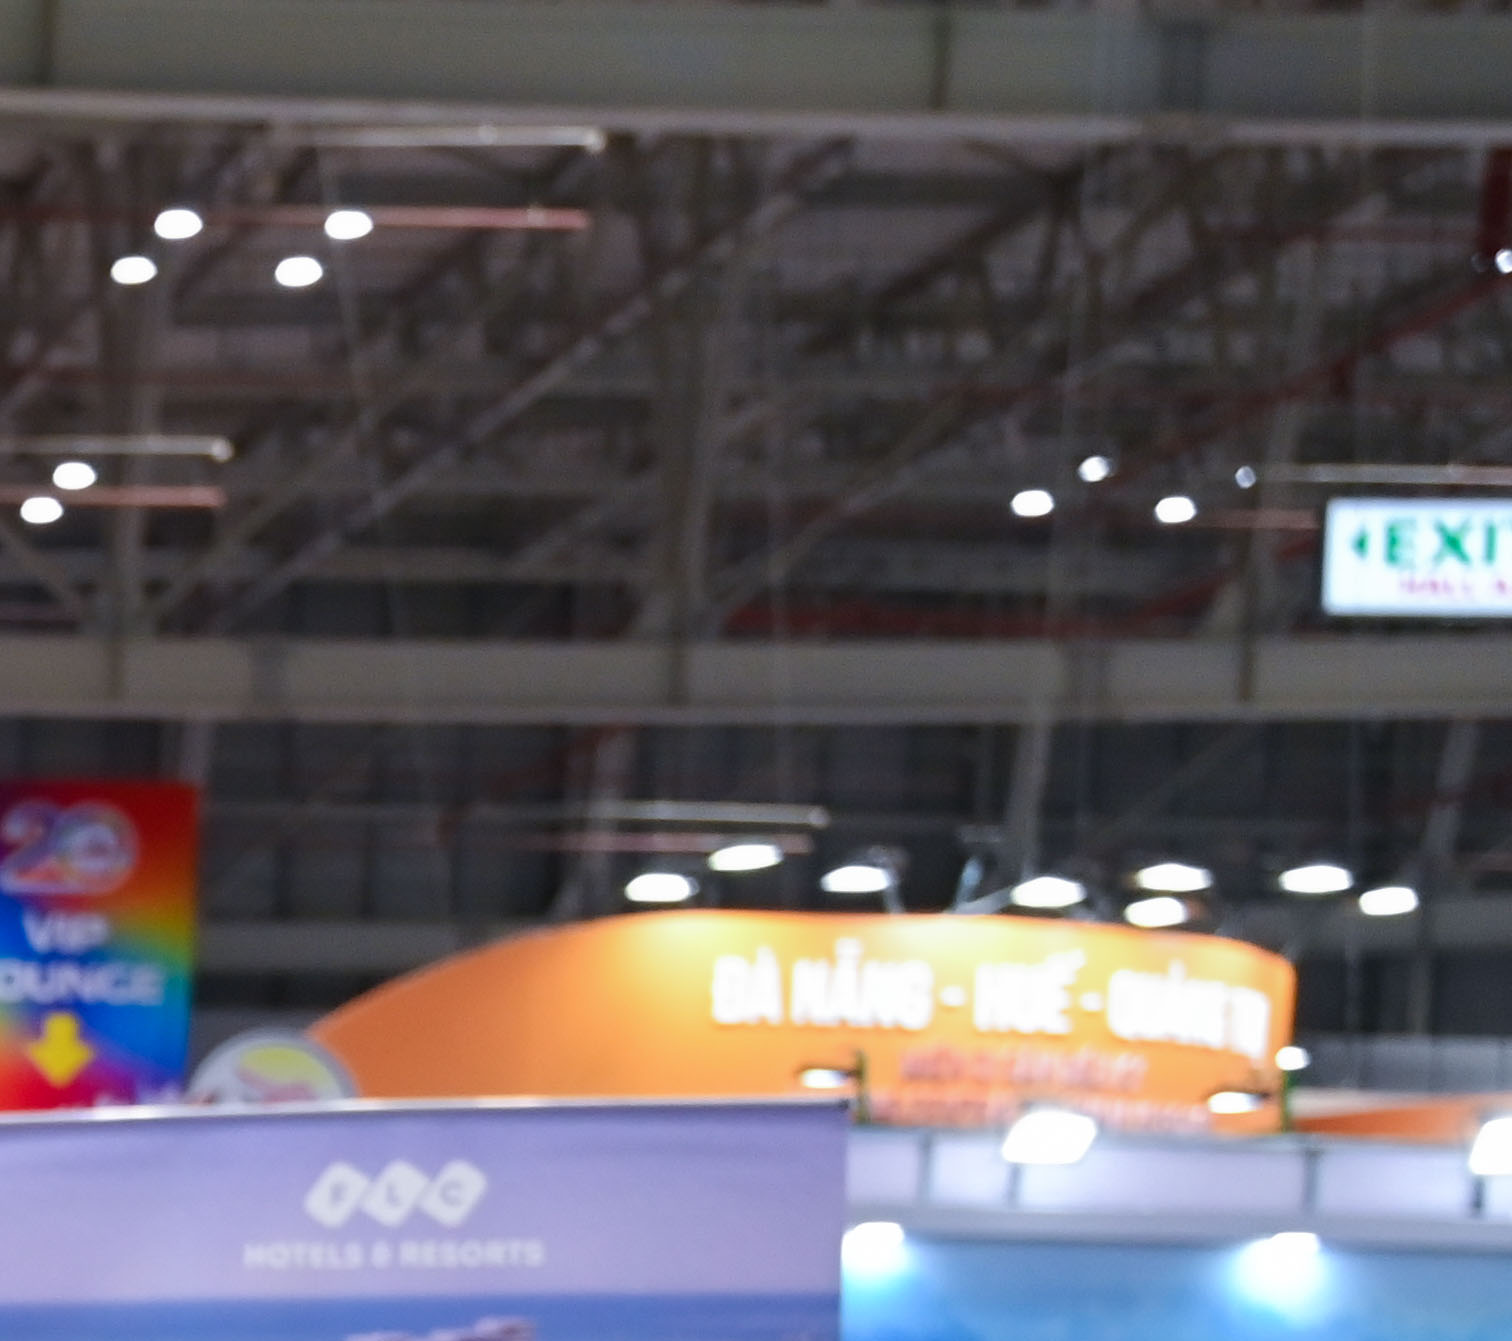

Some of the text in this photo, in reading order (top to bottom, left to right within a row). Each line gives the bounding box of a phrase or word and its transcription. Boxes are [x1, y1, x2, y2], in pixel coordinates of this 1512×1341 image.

[1385, 516, 1512, 568] EXI
[22, 911, 110, 953] VIP
[243, 1242, 364, 1269] HOTELS
[398, 1238, 546, 1268] RESORTS
